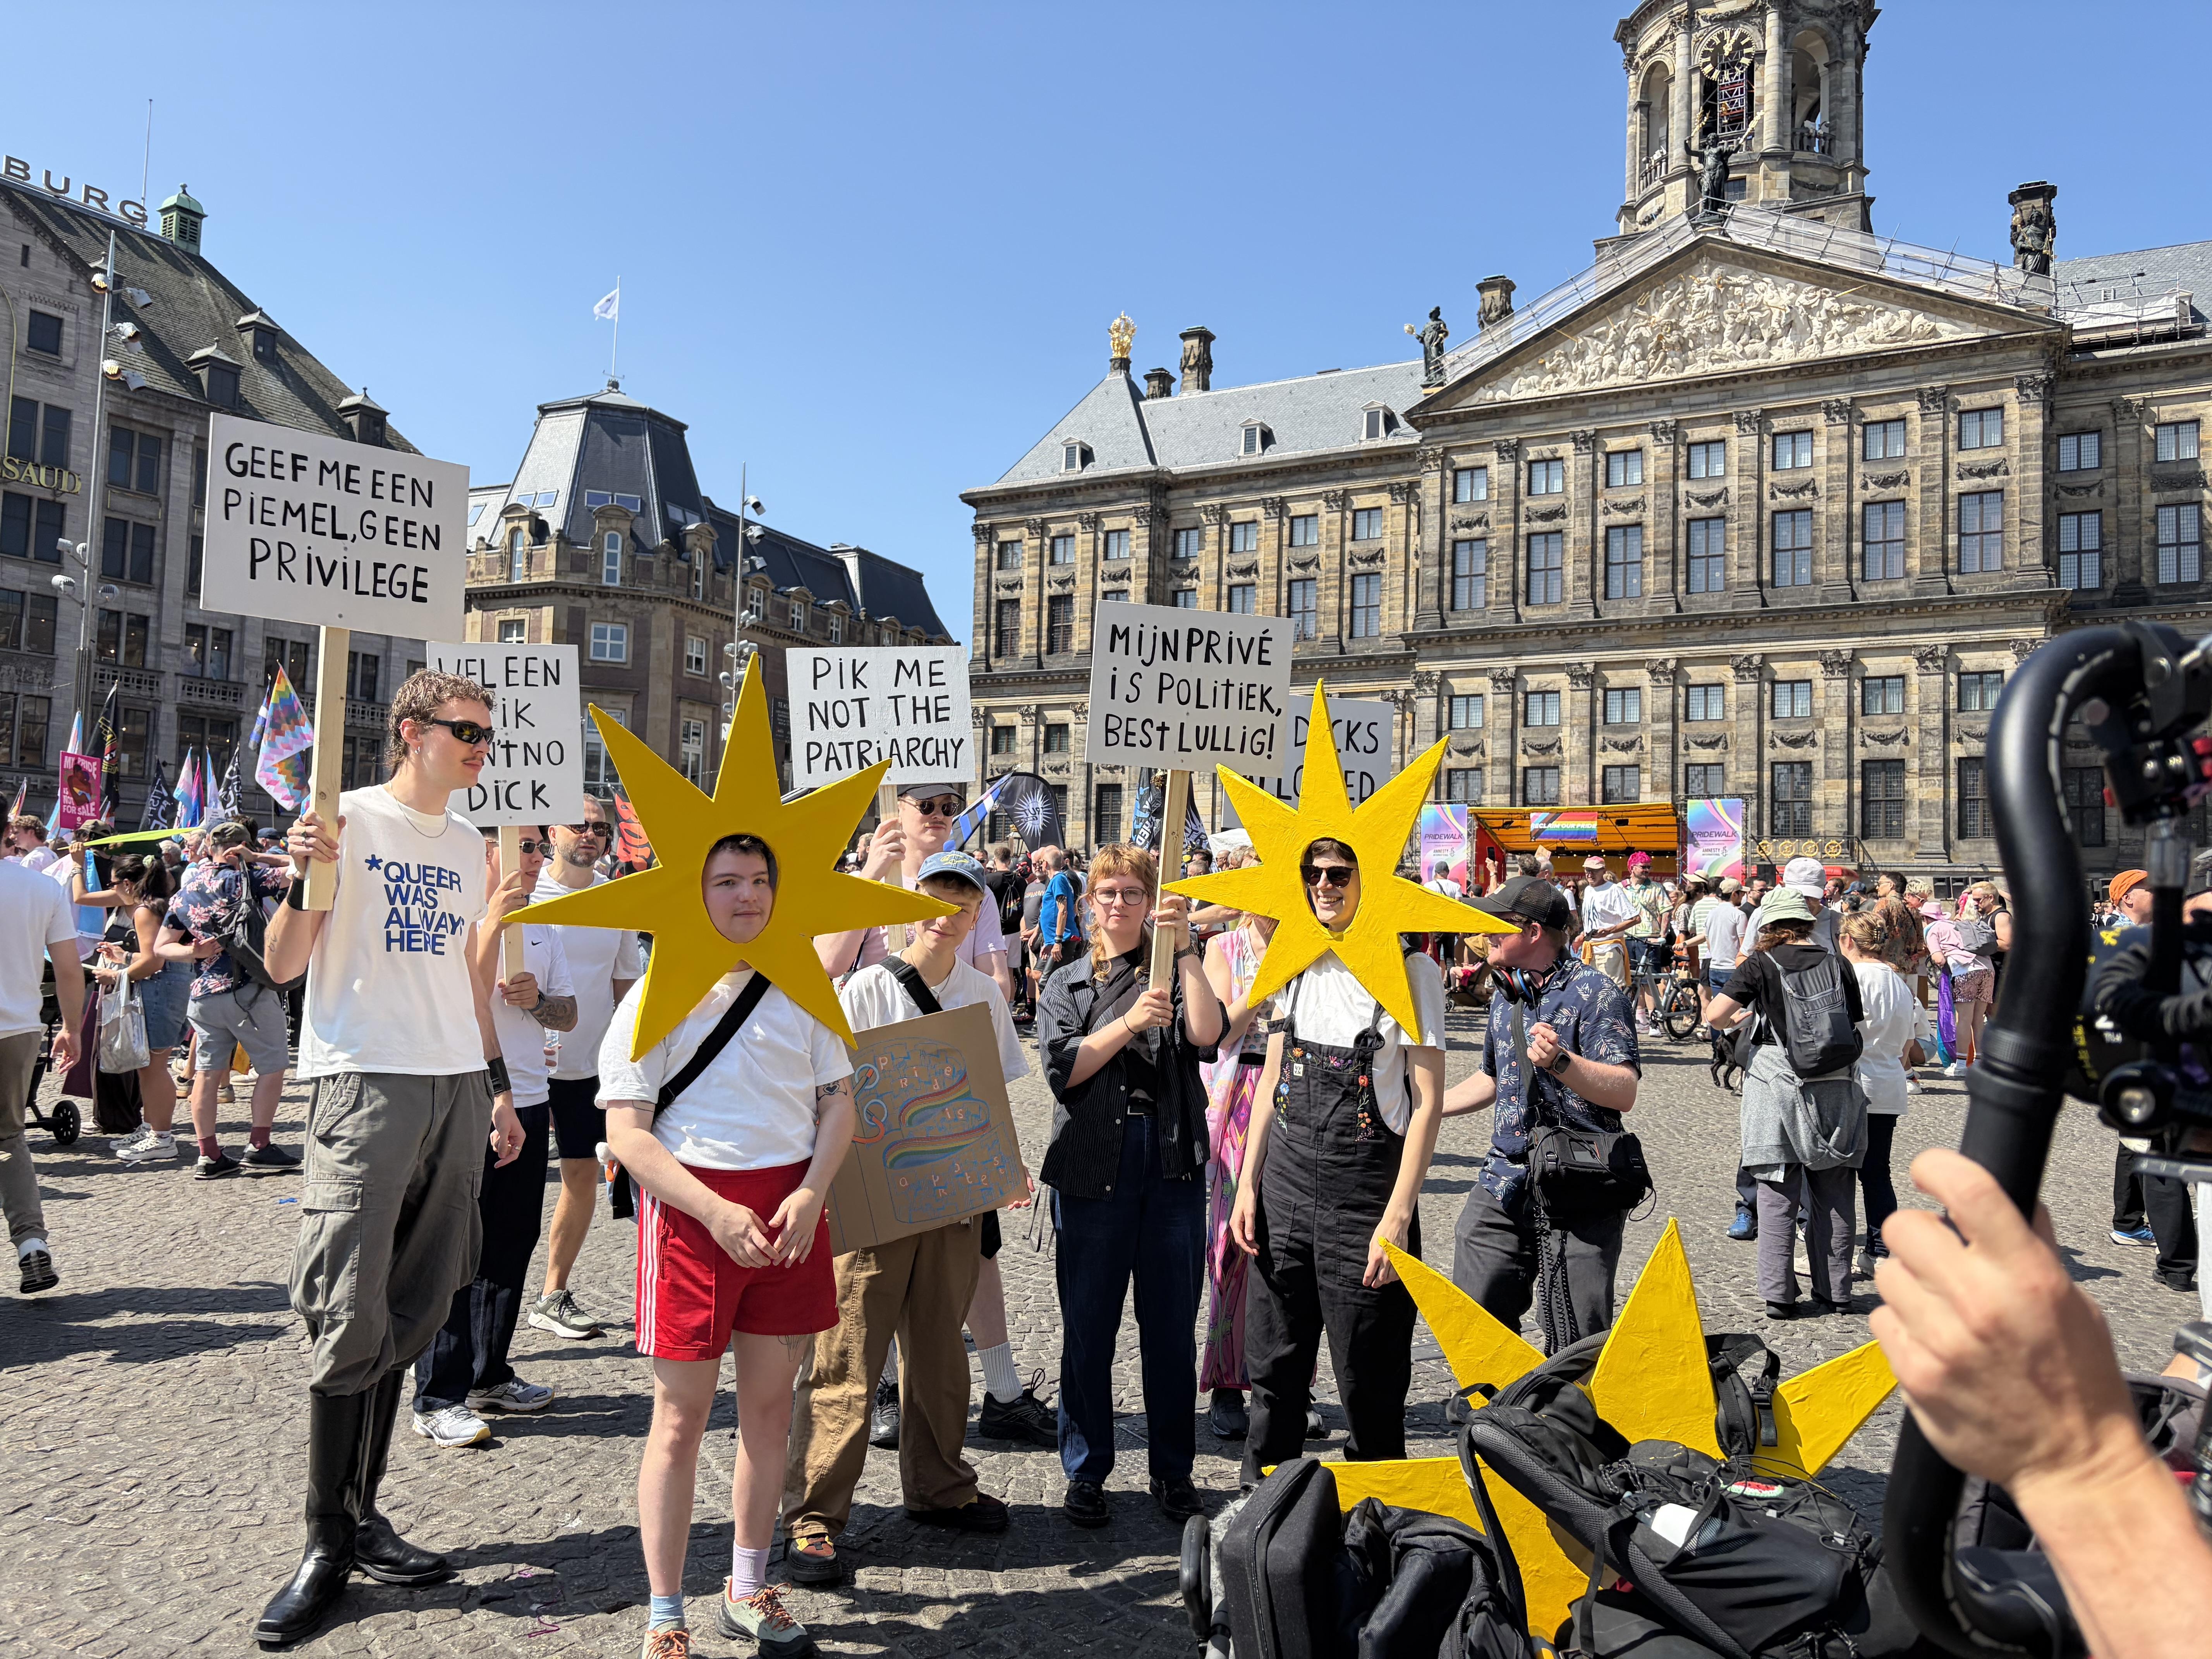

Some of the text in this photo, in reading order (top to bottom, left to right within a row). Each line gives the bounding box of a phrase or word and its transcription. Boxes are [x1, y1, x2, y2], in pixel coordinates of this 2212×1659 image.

[2, 155, 148, 223] BURG
[2, 456, 82, 494] SAUD
[225, 442, 433, 508] GEEF ME EEN
[505, 656, 560, 687] EEN
[894, 659, 946, 688] ME
[808, 696, 870, 732] NOT
[887, 694, 951, 726] THE
[1294, 715, 1379, 755] DCKS
[64, 755, 75, 769] MY
[77, 757, 97, 780] PRIDE
[523, 740, 565, 767] NO
[62, 801, 97, 817] FOR SALE
[383, 884, 438, 910] WAS
[386, 929, 447, 956] HERE
